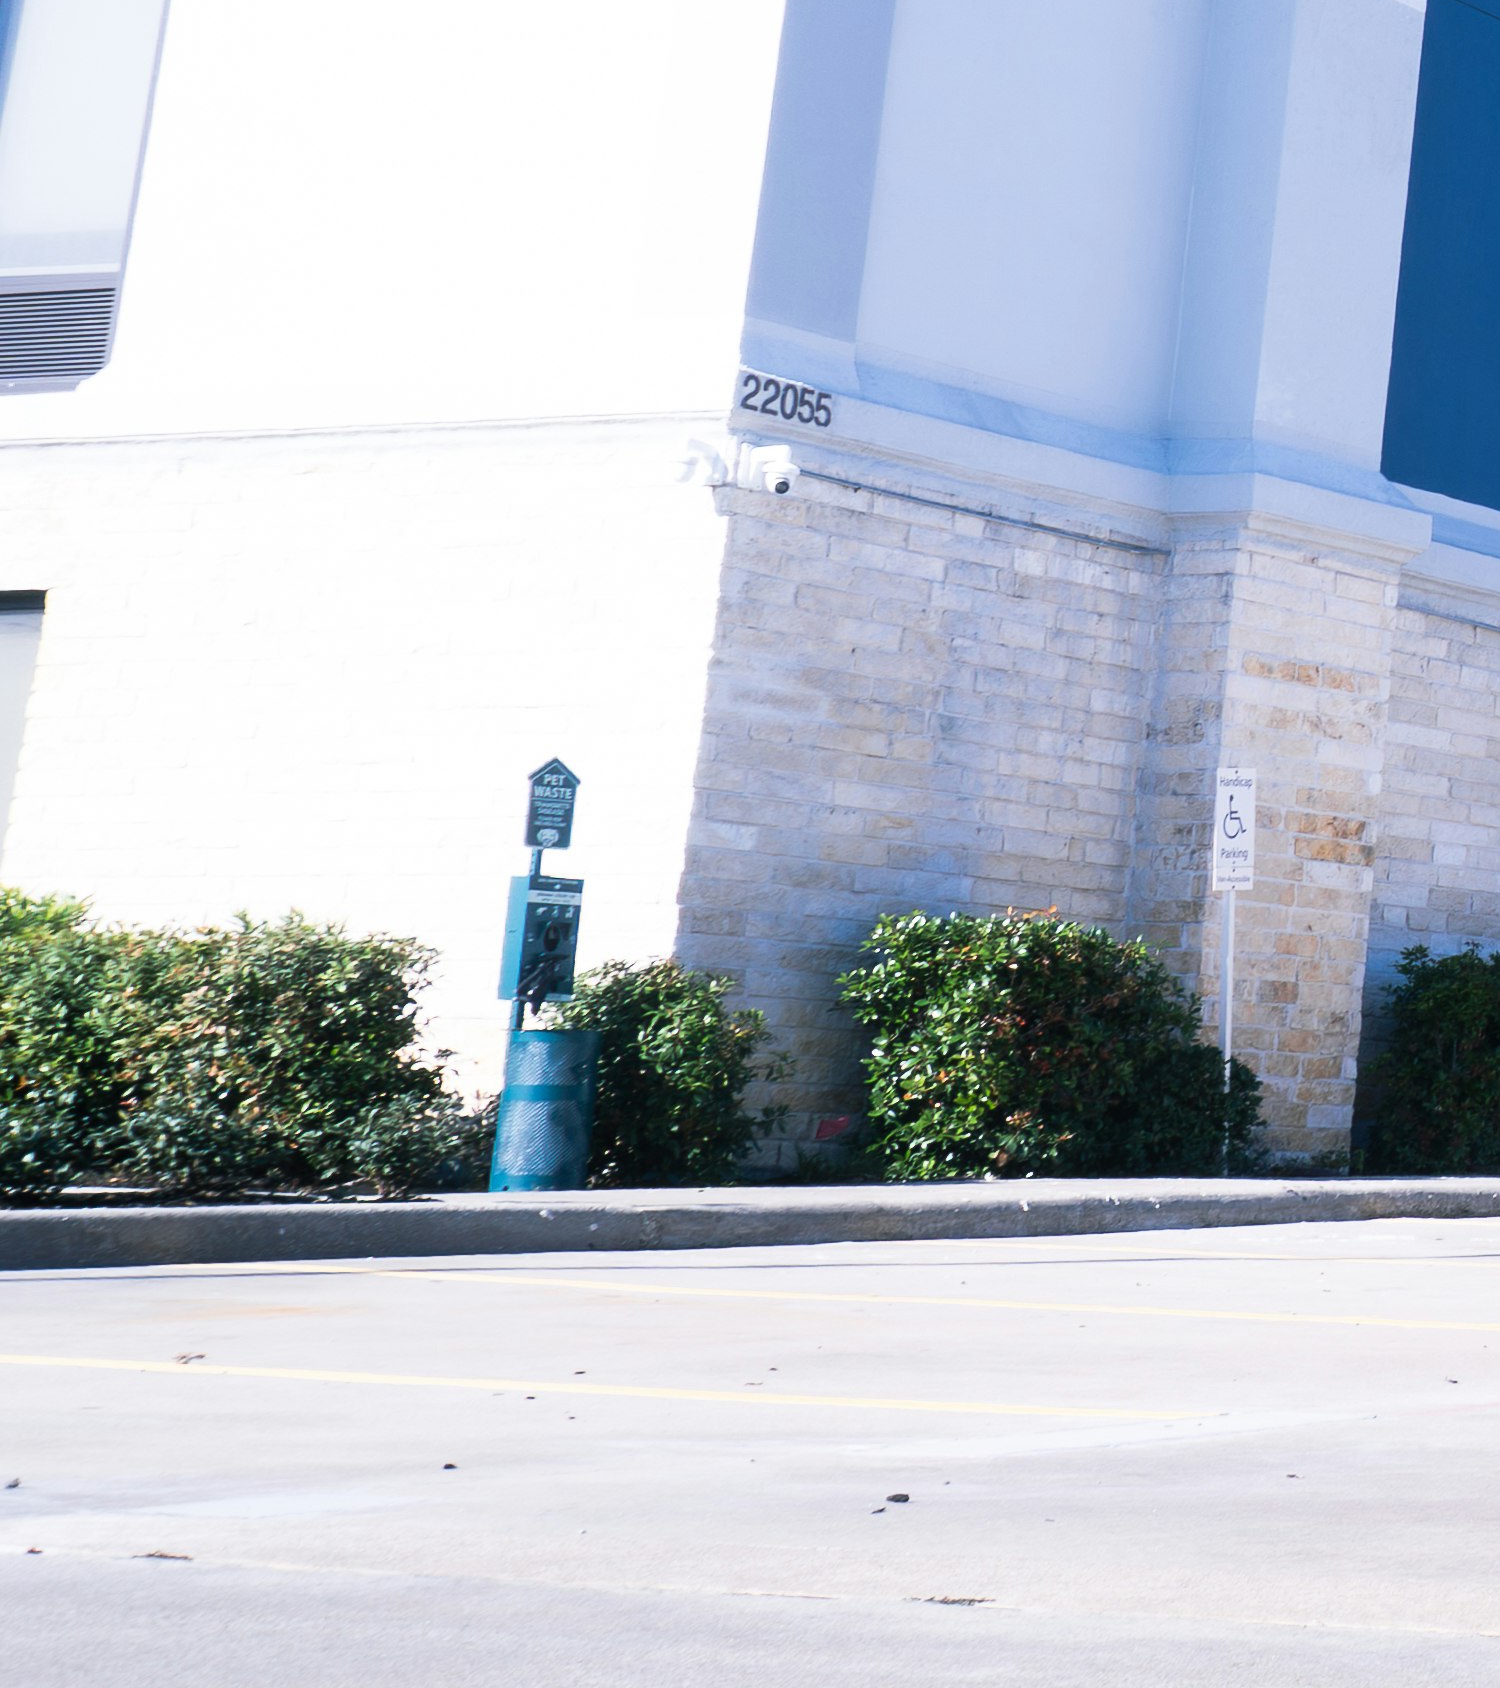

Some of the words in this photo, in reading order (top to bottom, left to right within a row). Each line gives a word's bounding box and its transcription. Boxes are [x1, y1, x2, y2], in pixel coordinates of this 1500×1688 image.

[740, 374, 832, 428] 22055
[543, 773, 567, 786] PET
[1219, 775, 1253, 790] Handicap
[533, 785, 573, 800] WASTE
[1221, 847, 1249, 861] Parking
